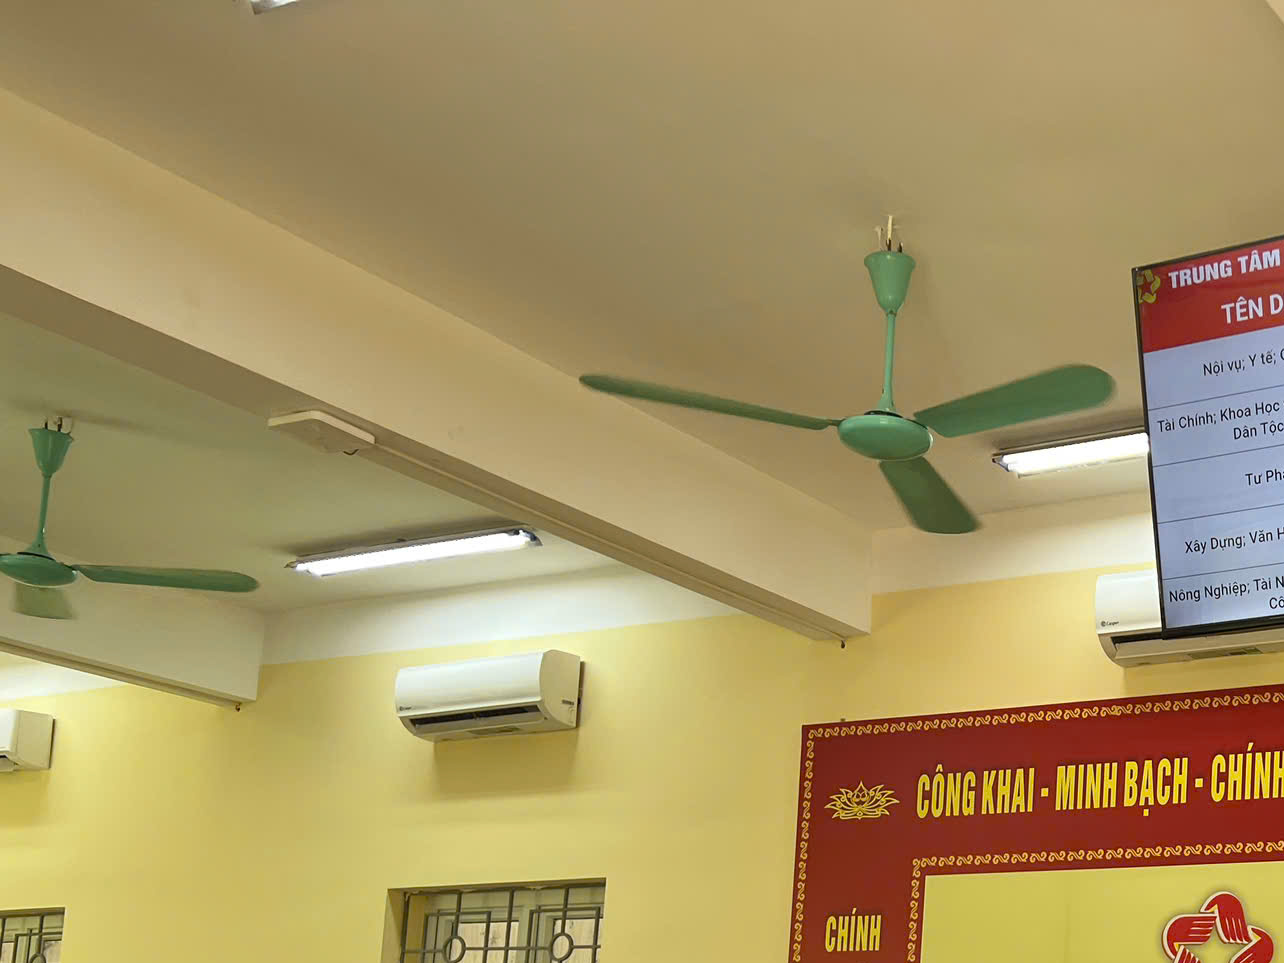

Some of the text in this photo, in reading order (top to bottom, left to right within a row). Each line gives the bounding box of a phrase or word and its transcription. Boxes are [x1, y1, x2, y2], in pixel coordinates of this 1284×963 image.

[1168, 260, 1232, 289] TRUNG
[1237, 250, 1281, 274] TÂM
[1221, 297, 1263, 324] TÊN
[1203, 360, 1224, 376] Nội
[1227, 358, 1246, 372] vụ;
[1248, 353, 1257, 367] Y
[1260, 349, 1277, 365] tế;
[1157, 419, 1175, 433] Tài
[1178, 411, 1217, 430] Chính;
[1220, 406, 1251, 421] Khoa
[1255, 400, 1280, 418] Học
[1233, 423, 1257, 440] Dân
[1260, 419, 1284, 436] Tộc
[1245, 471, 1262, 486] Tư
[1185, 538, 1206, 555] Xây
[1210, 534, 1246, 553] Dựng;
[1249, 528, 1273, 544] Văn
[1169, 586, 1200, 604] Nông
[1204, 580, 1250, 600] Nghiệp;
[1253, 576, 1272, 591] Tài
[916, 764, 976, 818] CÔNG
[981, 767, 1035, 814] KHAI
[1041, 787, 1049, 797] -
[1055, 762, 1118, 811] MINH
[1124, 757, 1189, 817] BẠCH
[1195, 778, 1203, 788] -
[825, 908, 882, 952] CHÍNH
